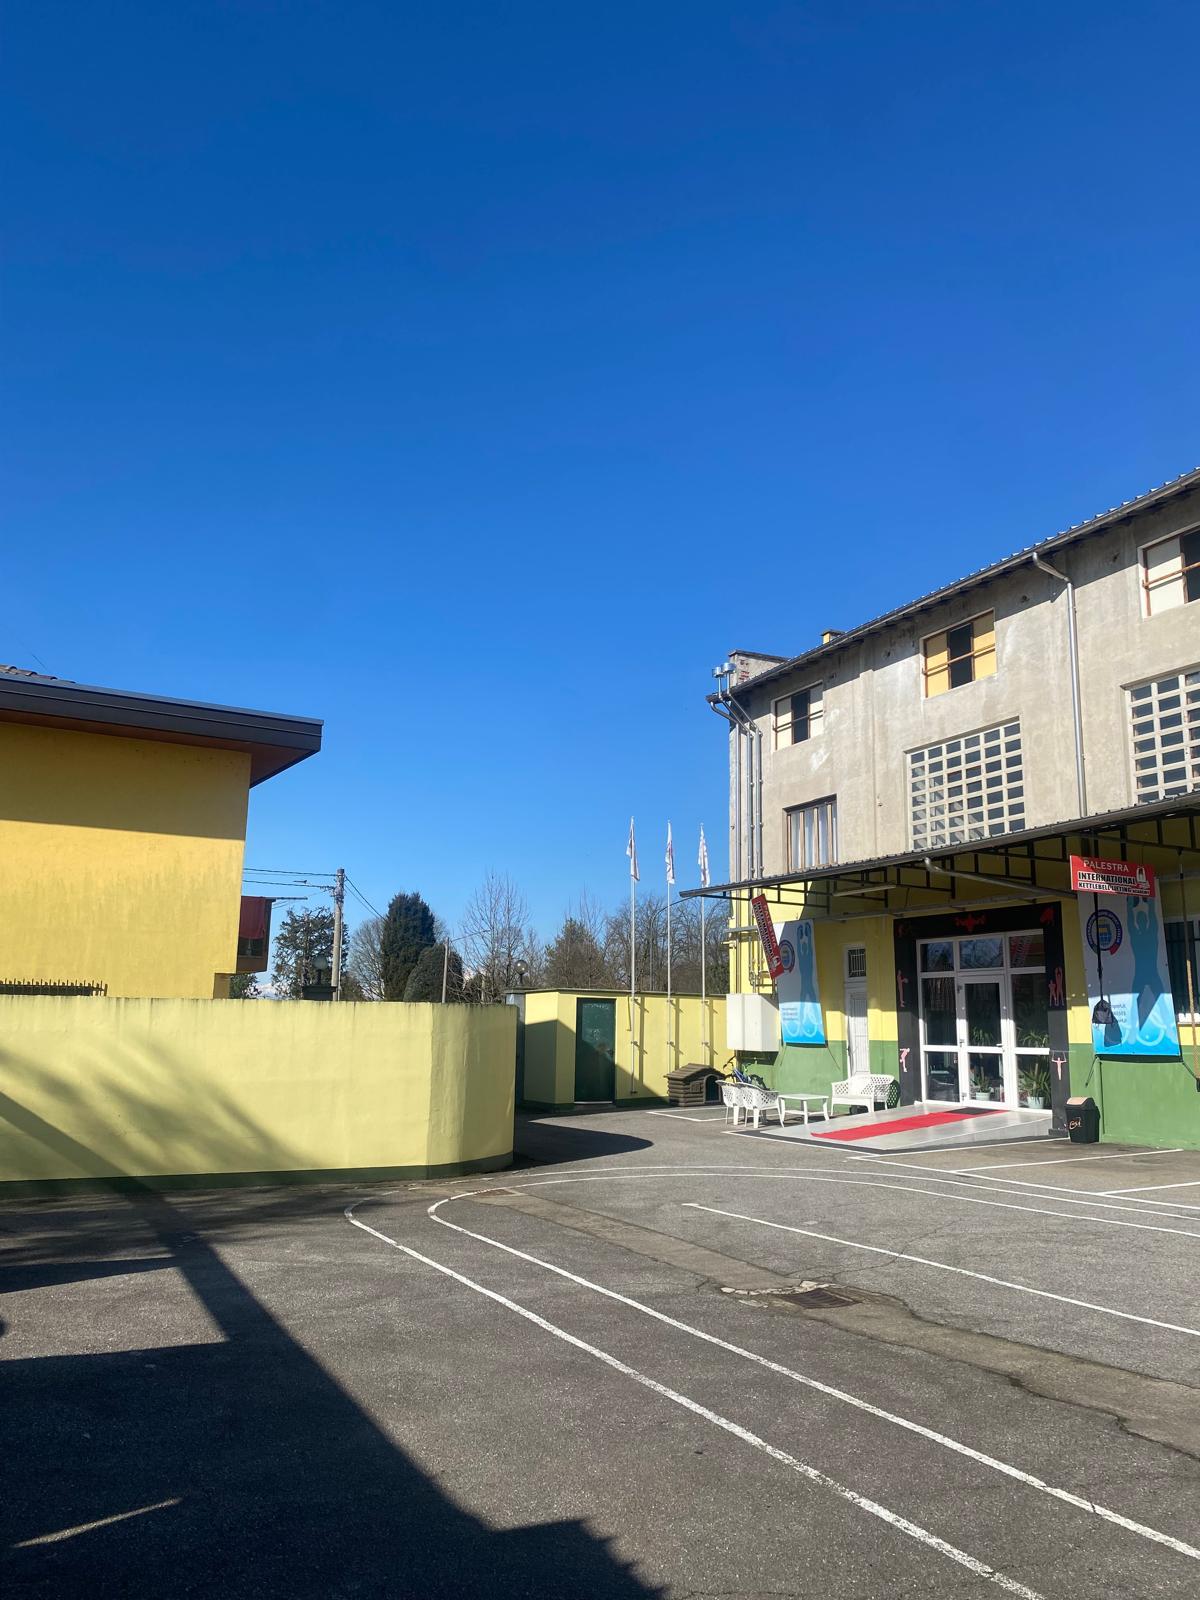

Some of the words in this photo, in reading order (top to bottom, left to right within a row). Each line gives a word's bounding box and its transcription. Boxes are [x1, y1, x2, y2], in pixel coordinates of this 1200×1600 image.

[1083, 859, 1130, 872] PALESTRA
[1078, 871, 1137, 885] INTERNATIONAL
[1078, 882, 1111, 891] KETTLEBELL
